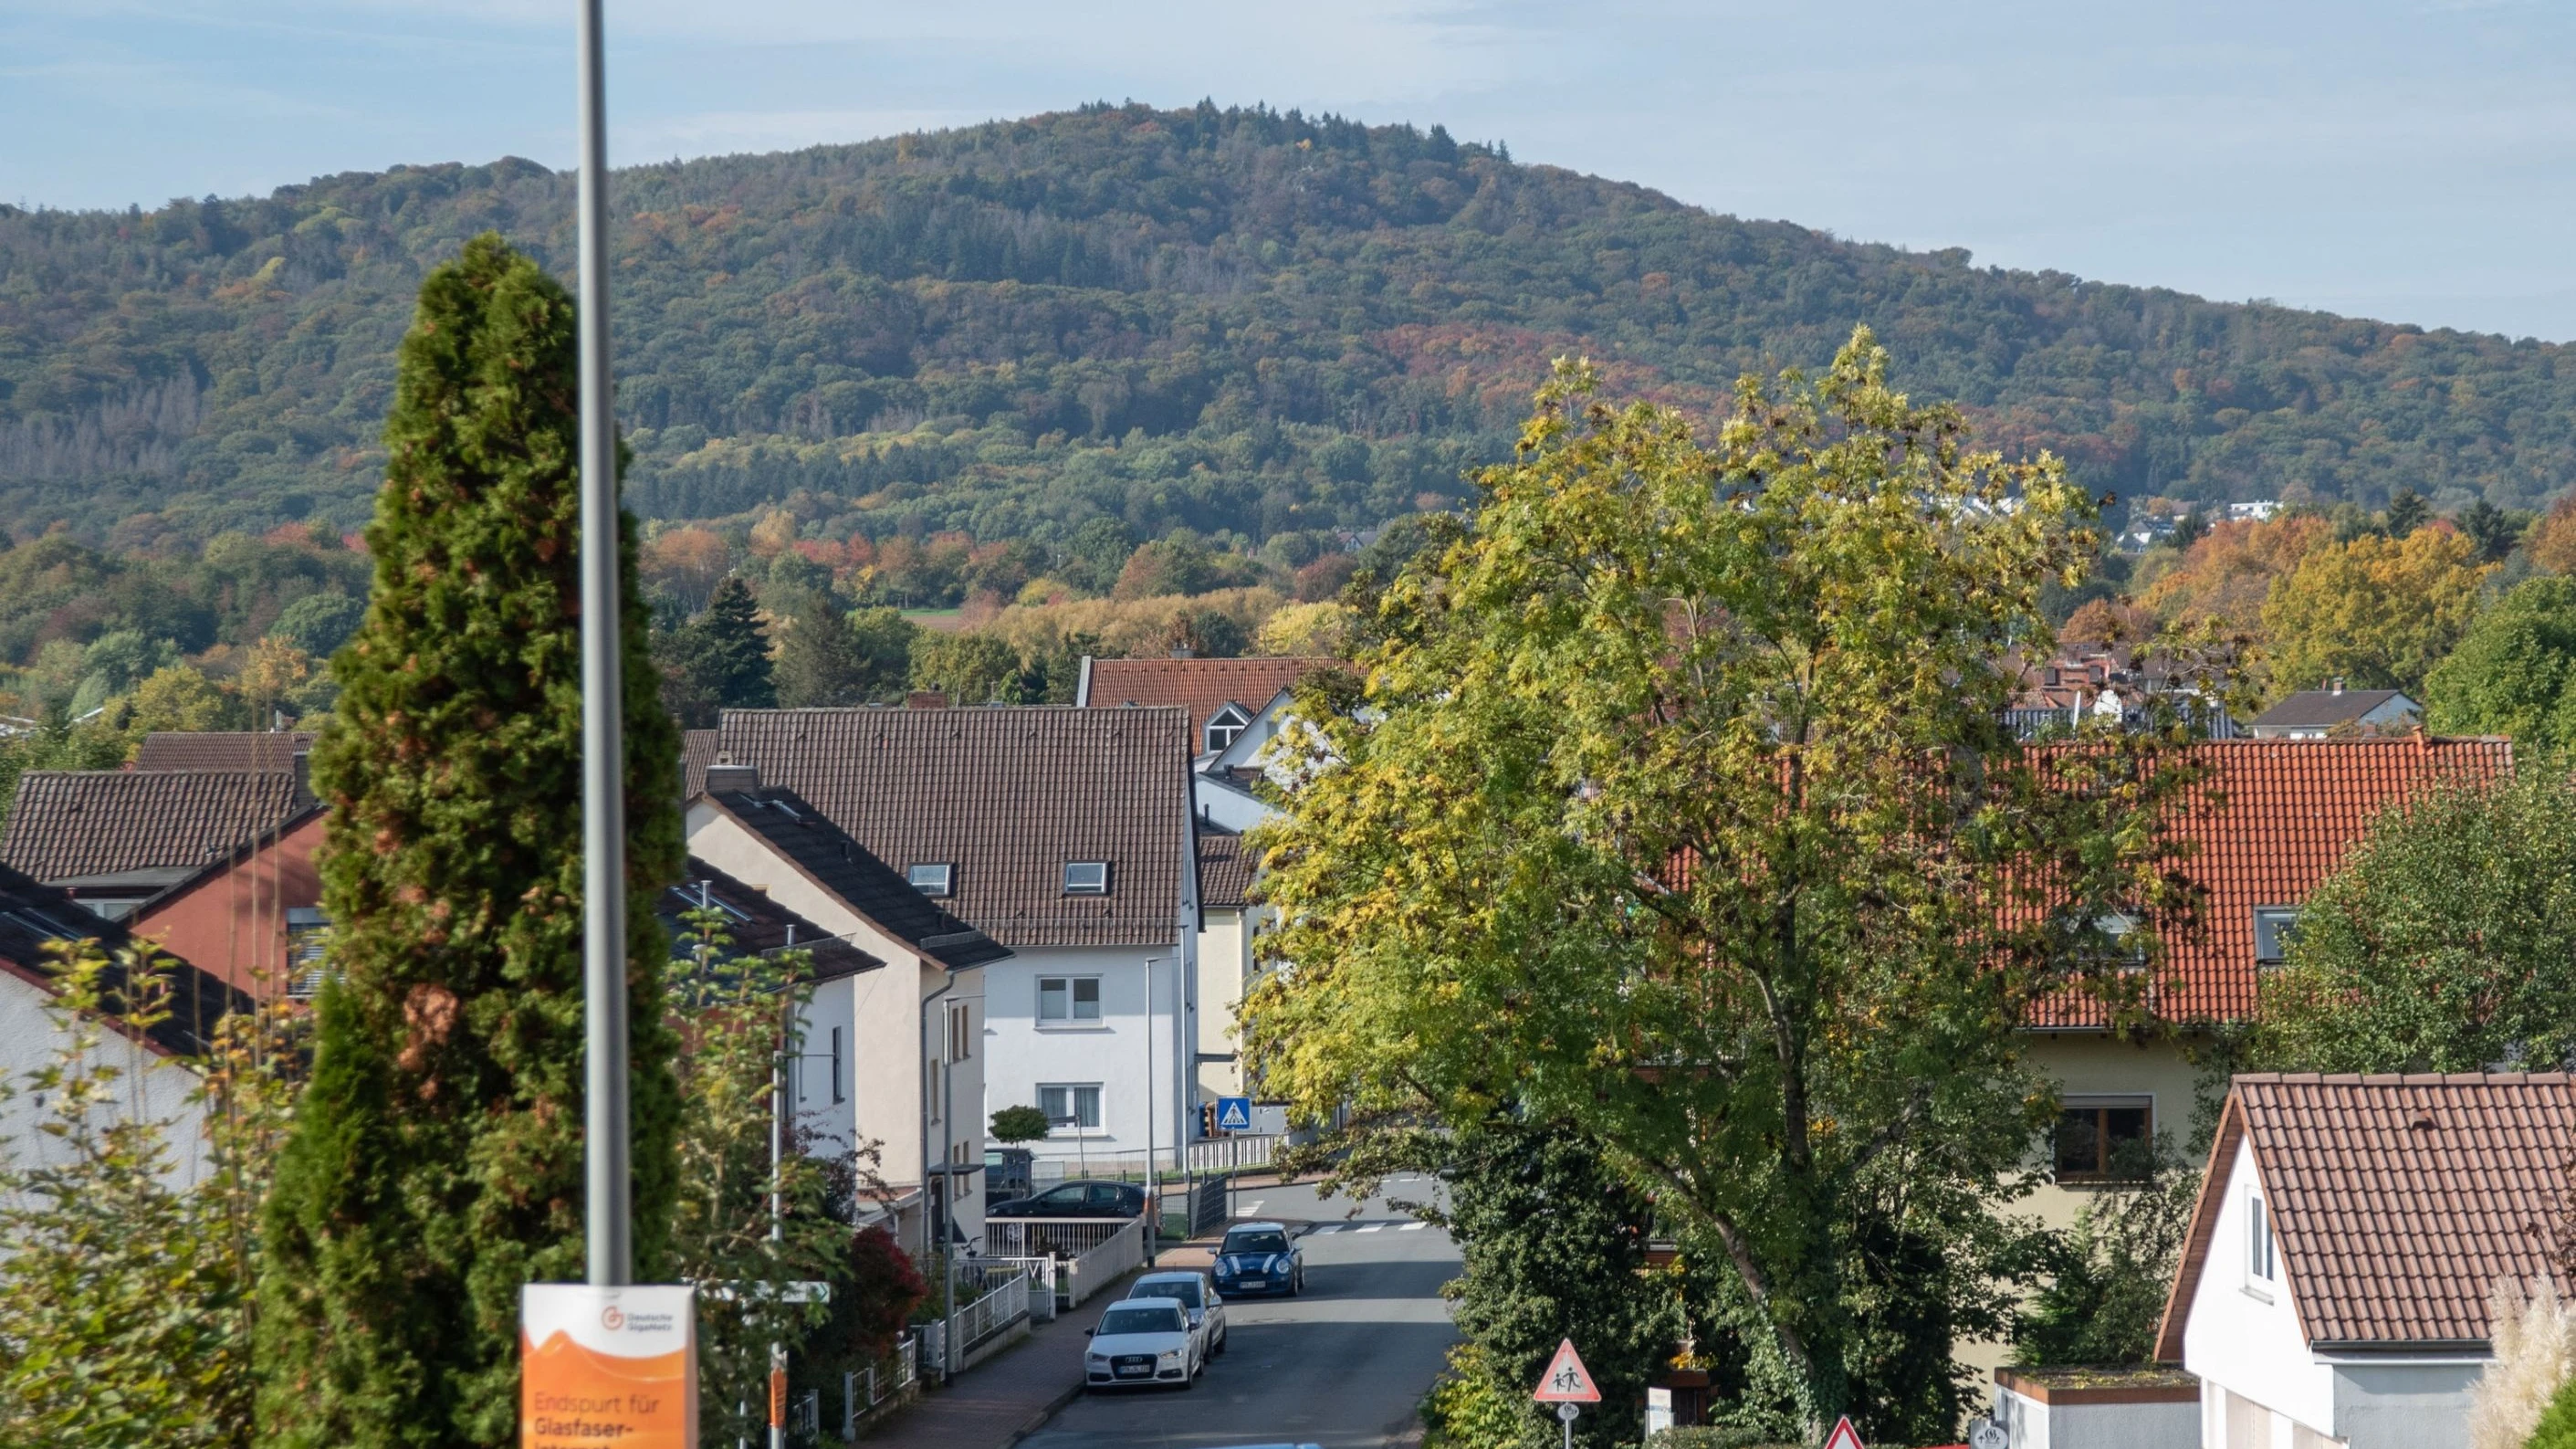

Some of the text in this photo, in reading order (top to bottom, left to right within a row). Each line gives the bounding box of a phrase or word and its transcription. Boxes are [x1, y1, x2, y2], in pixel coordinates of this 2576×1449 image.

[535, 1391, 661, 1415] Endspurt für
[535, 1417, 634, 1437] Glasfaser-
